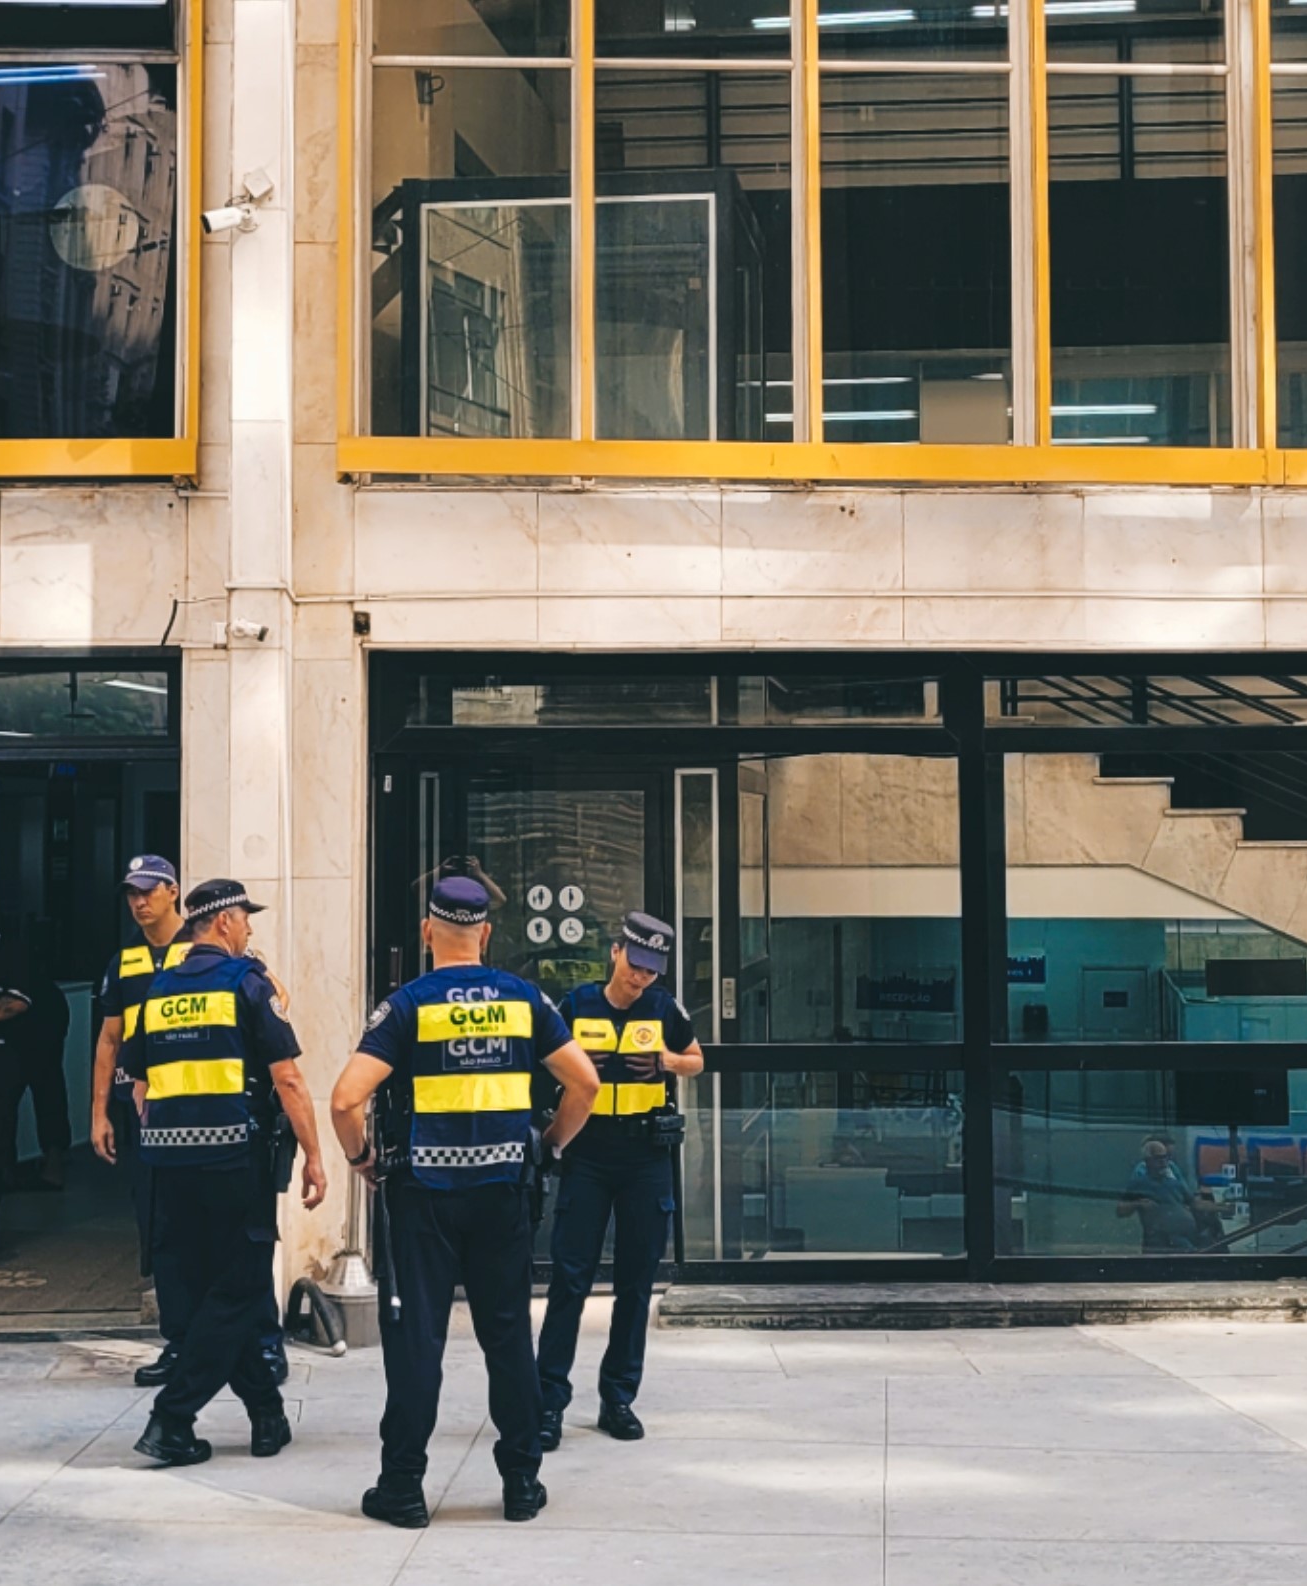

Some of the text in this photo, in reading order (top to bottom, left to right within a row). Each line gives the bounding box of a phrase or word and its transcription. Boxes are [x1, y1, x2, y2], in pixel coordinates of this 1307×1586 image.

[160, 995, 209, 1019] GCM
[449, 1004, 507, 1026] GCM
[447, 1036, 508, 1057] GCM
